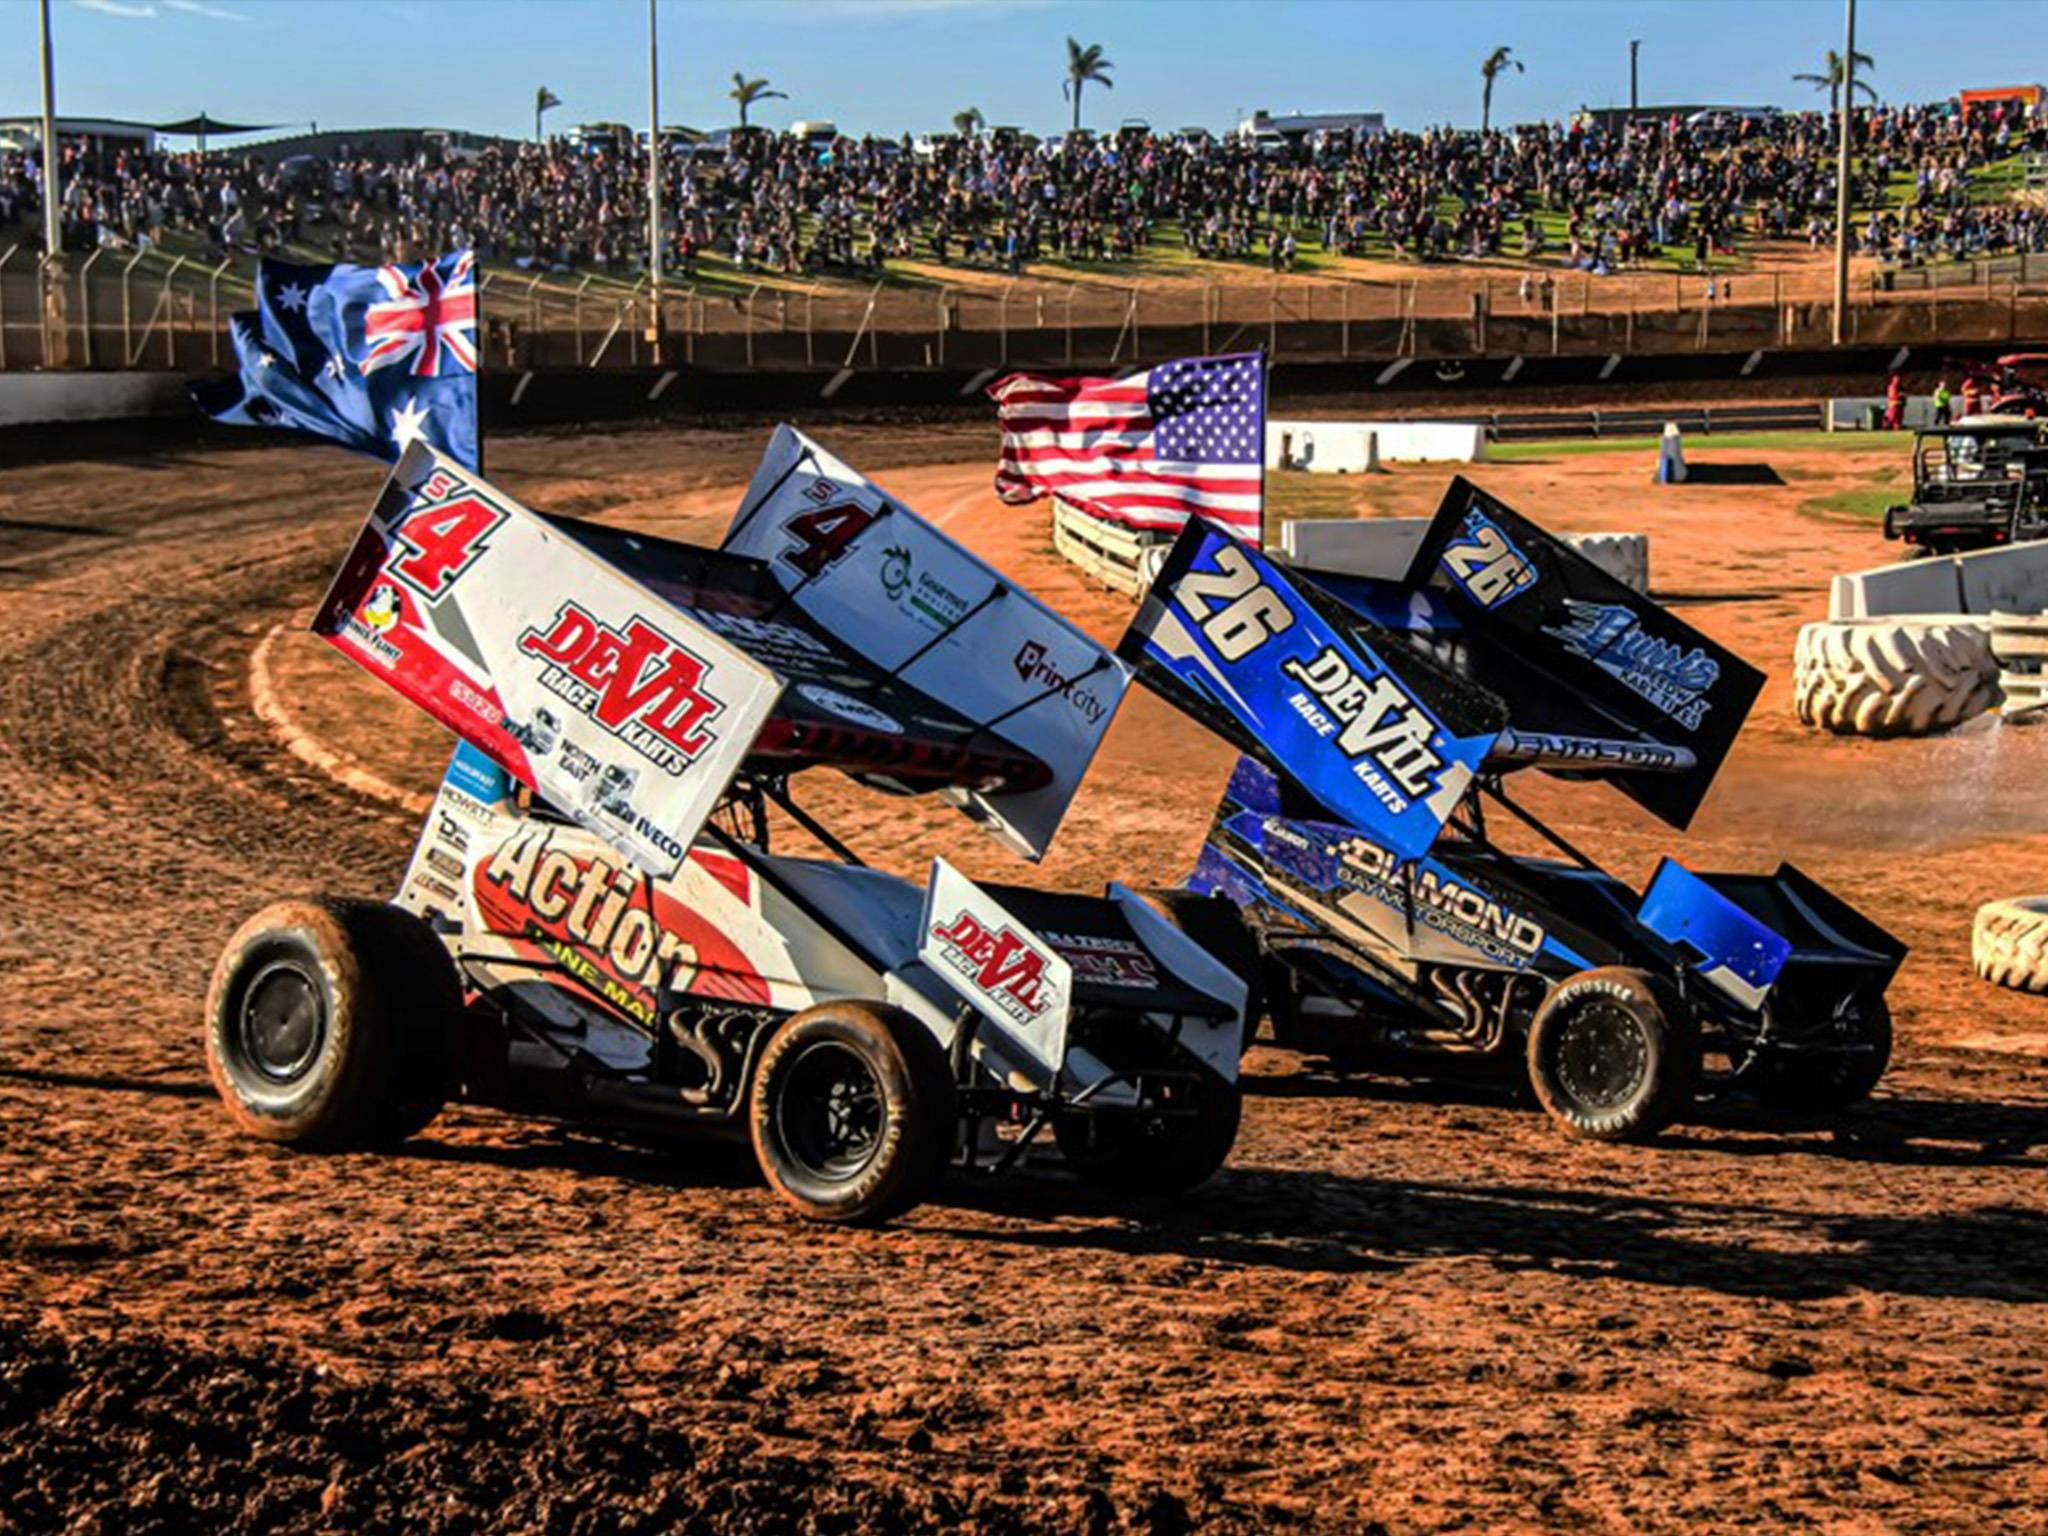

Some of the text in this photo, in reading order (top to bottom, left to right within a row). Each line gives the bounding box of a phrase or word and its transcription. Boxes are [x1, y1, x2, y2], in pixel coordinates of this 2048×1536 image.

[1442, 527, 1531, 606] 26
[1175, 545, 1294, 661] 26
[518, 601, 723, 760] DEVIL
[538, 667, 598, 715] RACE
[616, 720, 689, 777] KARTS
[1284, 649, 1440, 796] DEVIL
[1288, 692, 1336, 738] RACE
[557, 756, 591, 784] EAST
[560, 738, 601, 775] NORTH
[1352, 761, 1409, 815] KARTS
[635, 816, 684, 860] IVECO
[486, 822, 701, 992] Action
[1342, 836, 1546, 955] DIAMOND
[930, 912, 1054, 1015] DEVIL
